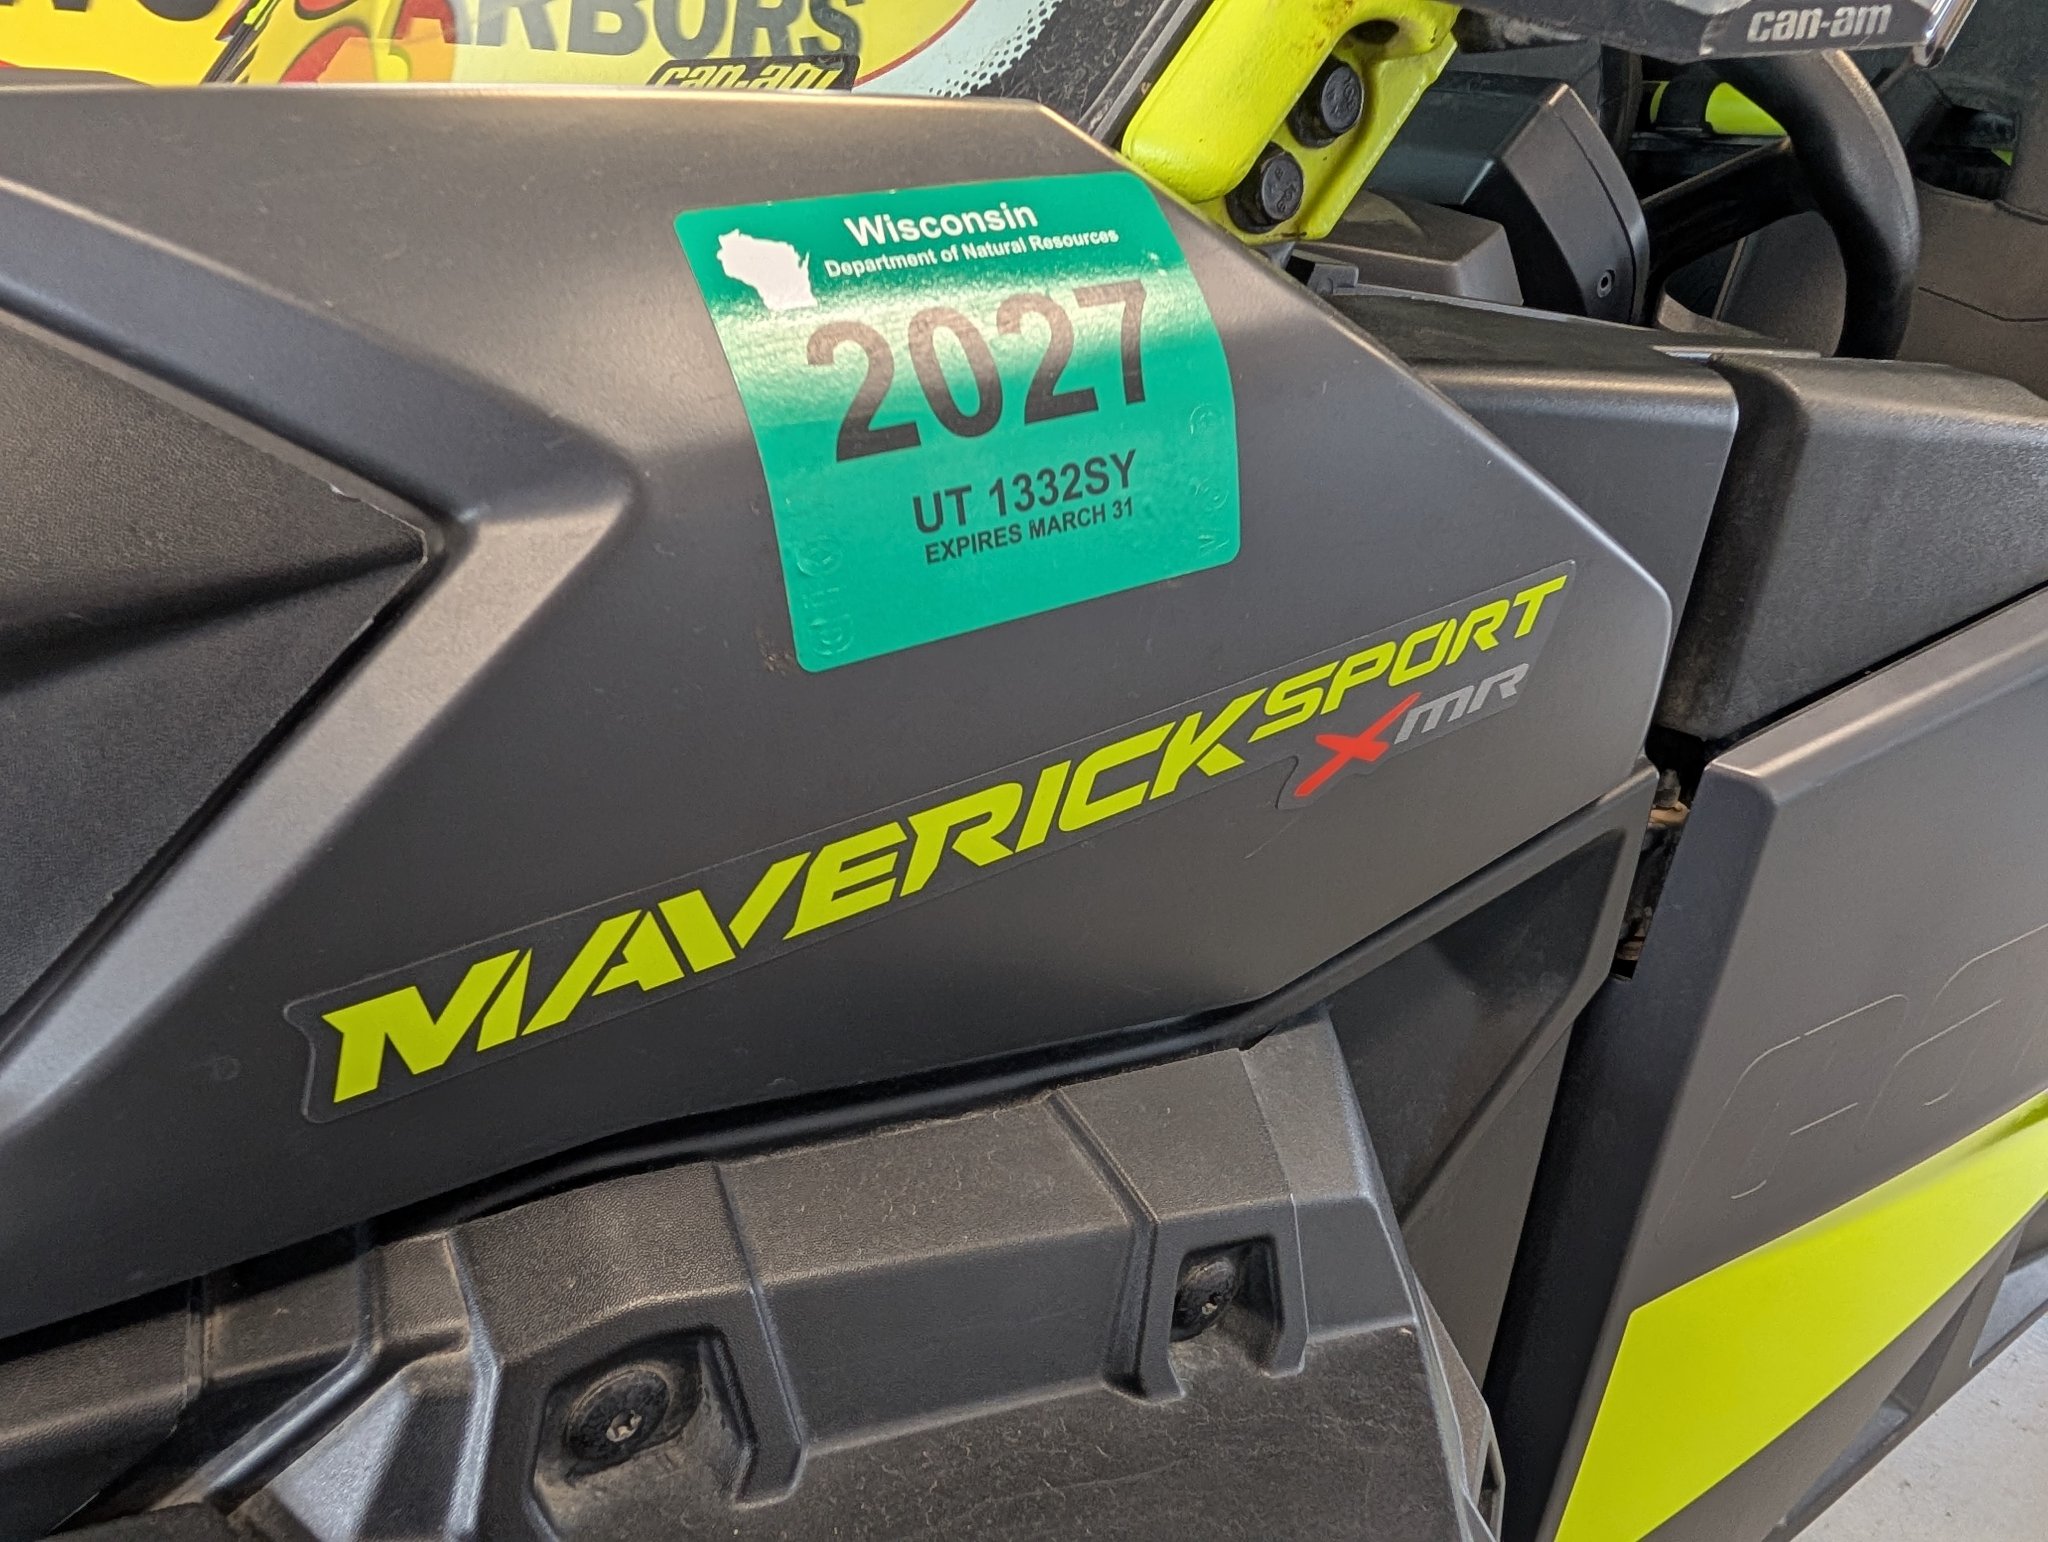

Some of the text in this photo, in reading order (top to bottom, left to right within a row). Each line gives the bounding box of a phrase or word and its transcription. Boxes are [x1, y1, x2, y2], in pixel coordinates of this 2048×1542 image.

[1747, 4, 1893, 43] can-am
[824, 229, 1120, 278] Department of Natural Resources
[844, 201, 1038, 247] Wisconsin
[806, 279, 1148, 462] 2027
[912, 448, 1136, 534] UT 1332SY
[925, 496, 1133, 565] EXPIRES MARCH 31
[321, 575, 1568, 1104] MAVERICK SPORT
